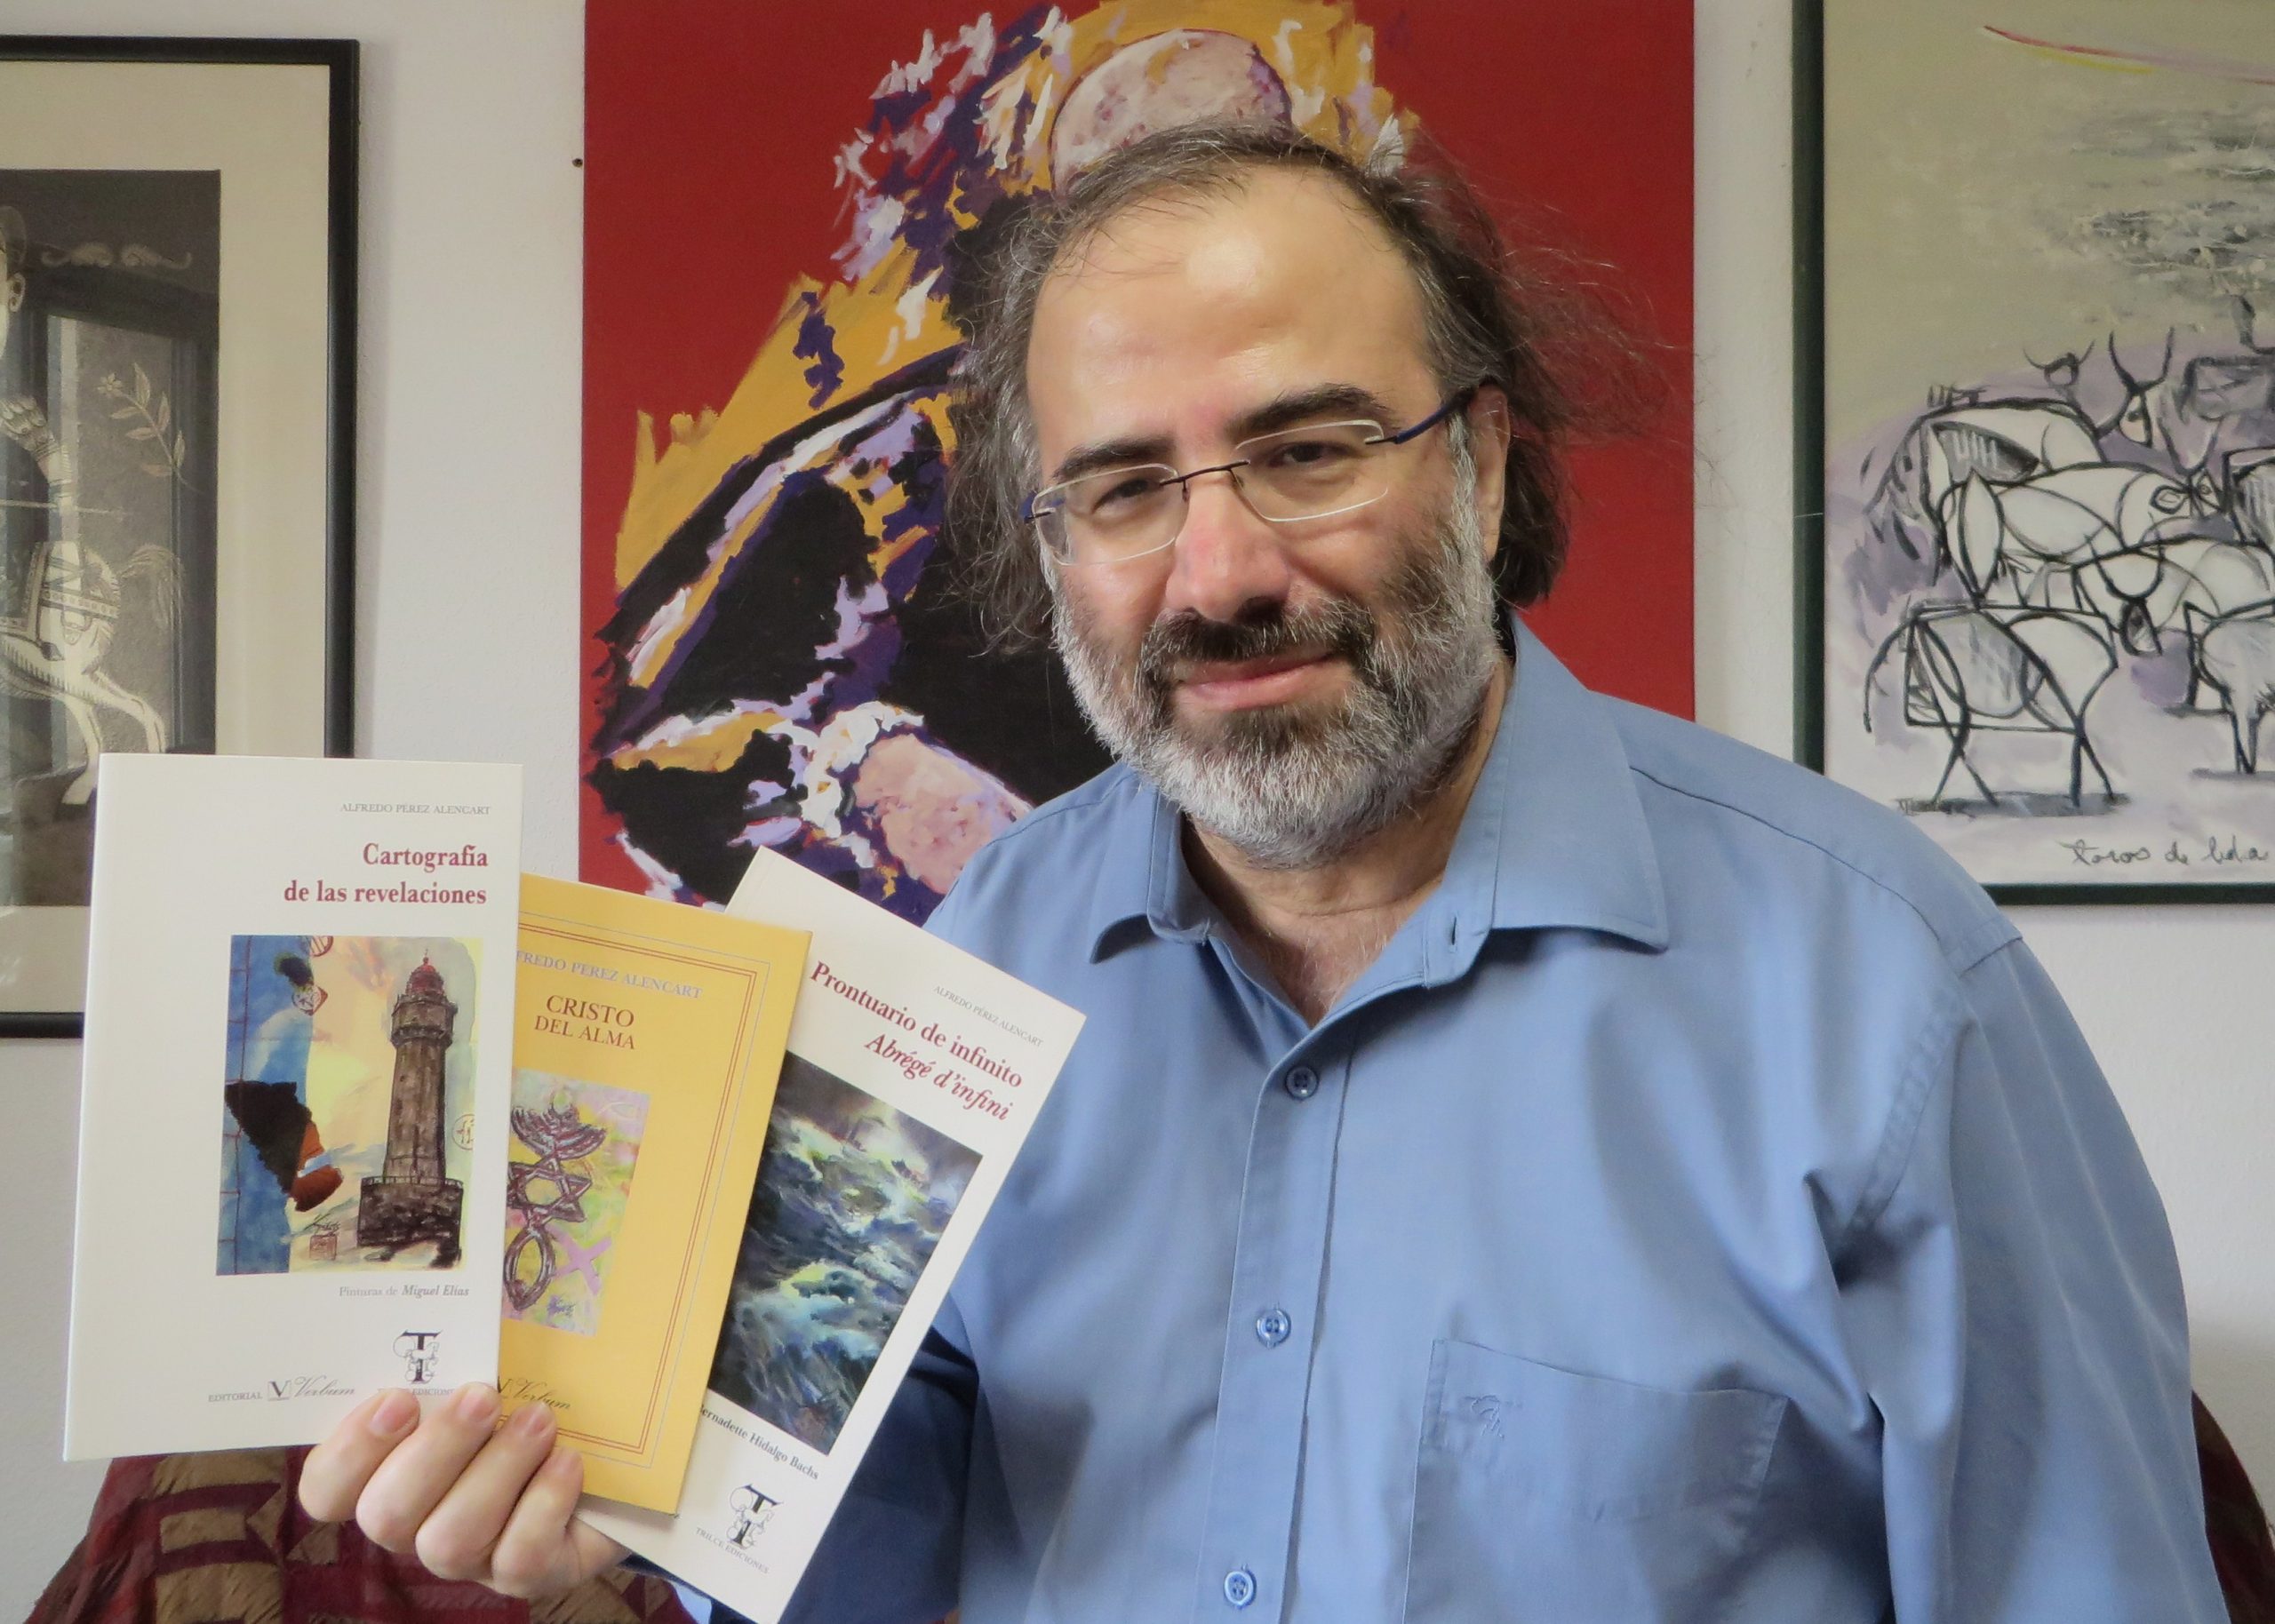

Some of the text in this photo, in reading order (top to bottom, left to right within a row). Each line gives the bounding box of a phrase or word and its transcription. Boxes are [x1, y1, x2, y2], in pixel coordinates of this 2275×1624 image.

[339, 802, 393, 813] ALFREDO
[434, 805, 491, 815] ALENCART
[363, 842, 488, 873] Cartografía
[283, 879, 487, 904] de las revelaciones
[515, 950, 566, 970] FREDO
[622, 974, 703, 999] ALENCART
[546, 994, 635, 1028] CRISTO
[810, 960, 1022, 1087] Prontuario de infinito
[933, 985, 972, 1010] ALFREDO
[999, 1020, 1044, 1047] ALENCART
[534, 1015, 635, 1050] DEL ALMA
[864, 1033, 937, 1080] Abrégé
[339, 1286, 382, 1296] Pinturas
[386, 1286, 398, 1296] de
[401, 1285, 440, 1299] Miguel
[208, 1391, 263, 1403] EDITORIAL
[412, 1388, 455, 1397] EDICION
[700, 1405, 819, 1481] ernadette Hidalgo Bachs
[725, 1545, 770, 1573] EDICIONES
